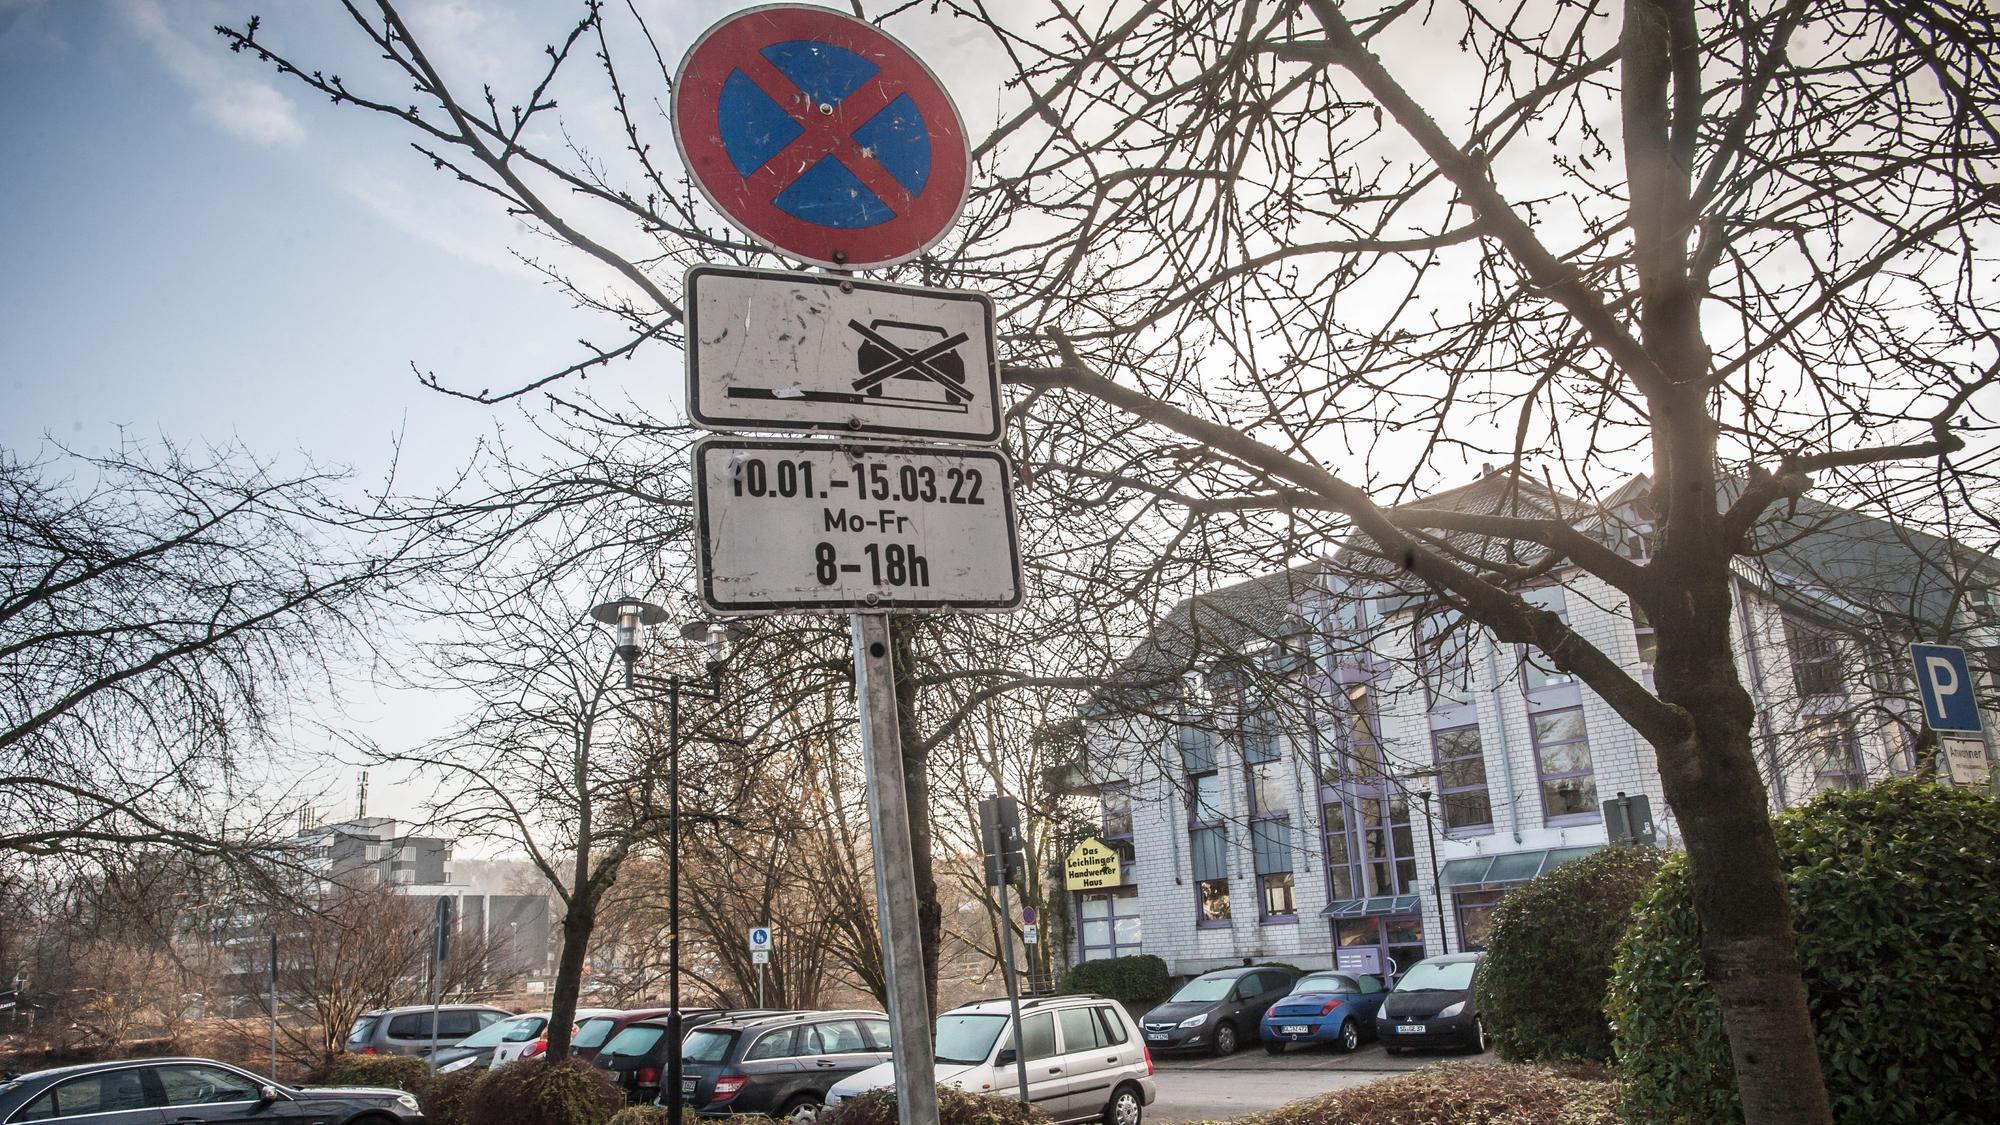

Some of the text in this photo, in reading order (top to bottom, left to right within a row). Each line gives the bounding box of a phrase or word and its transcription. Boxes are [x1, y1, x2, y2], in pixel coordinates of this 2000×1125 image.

[823, 507, 909, 534] Mo-Fr
[814, 541, 930, 587] 8-18h
[1925, 656, 1958, 719] P
[1082, 848, 1098, 856] Das
[1067, 856, 1115, 868] Leichlinger
[1068, 867, 1116, 879] Handwerker
[1083, 879, 1103, 887] Haus
